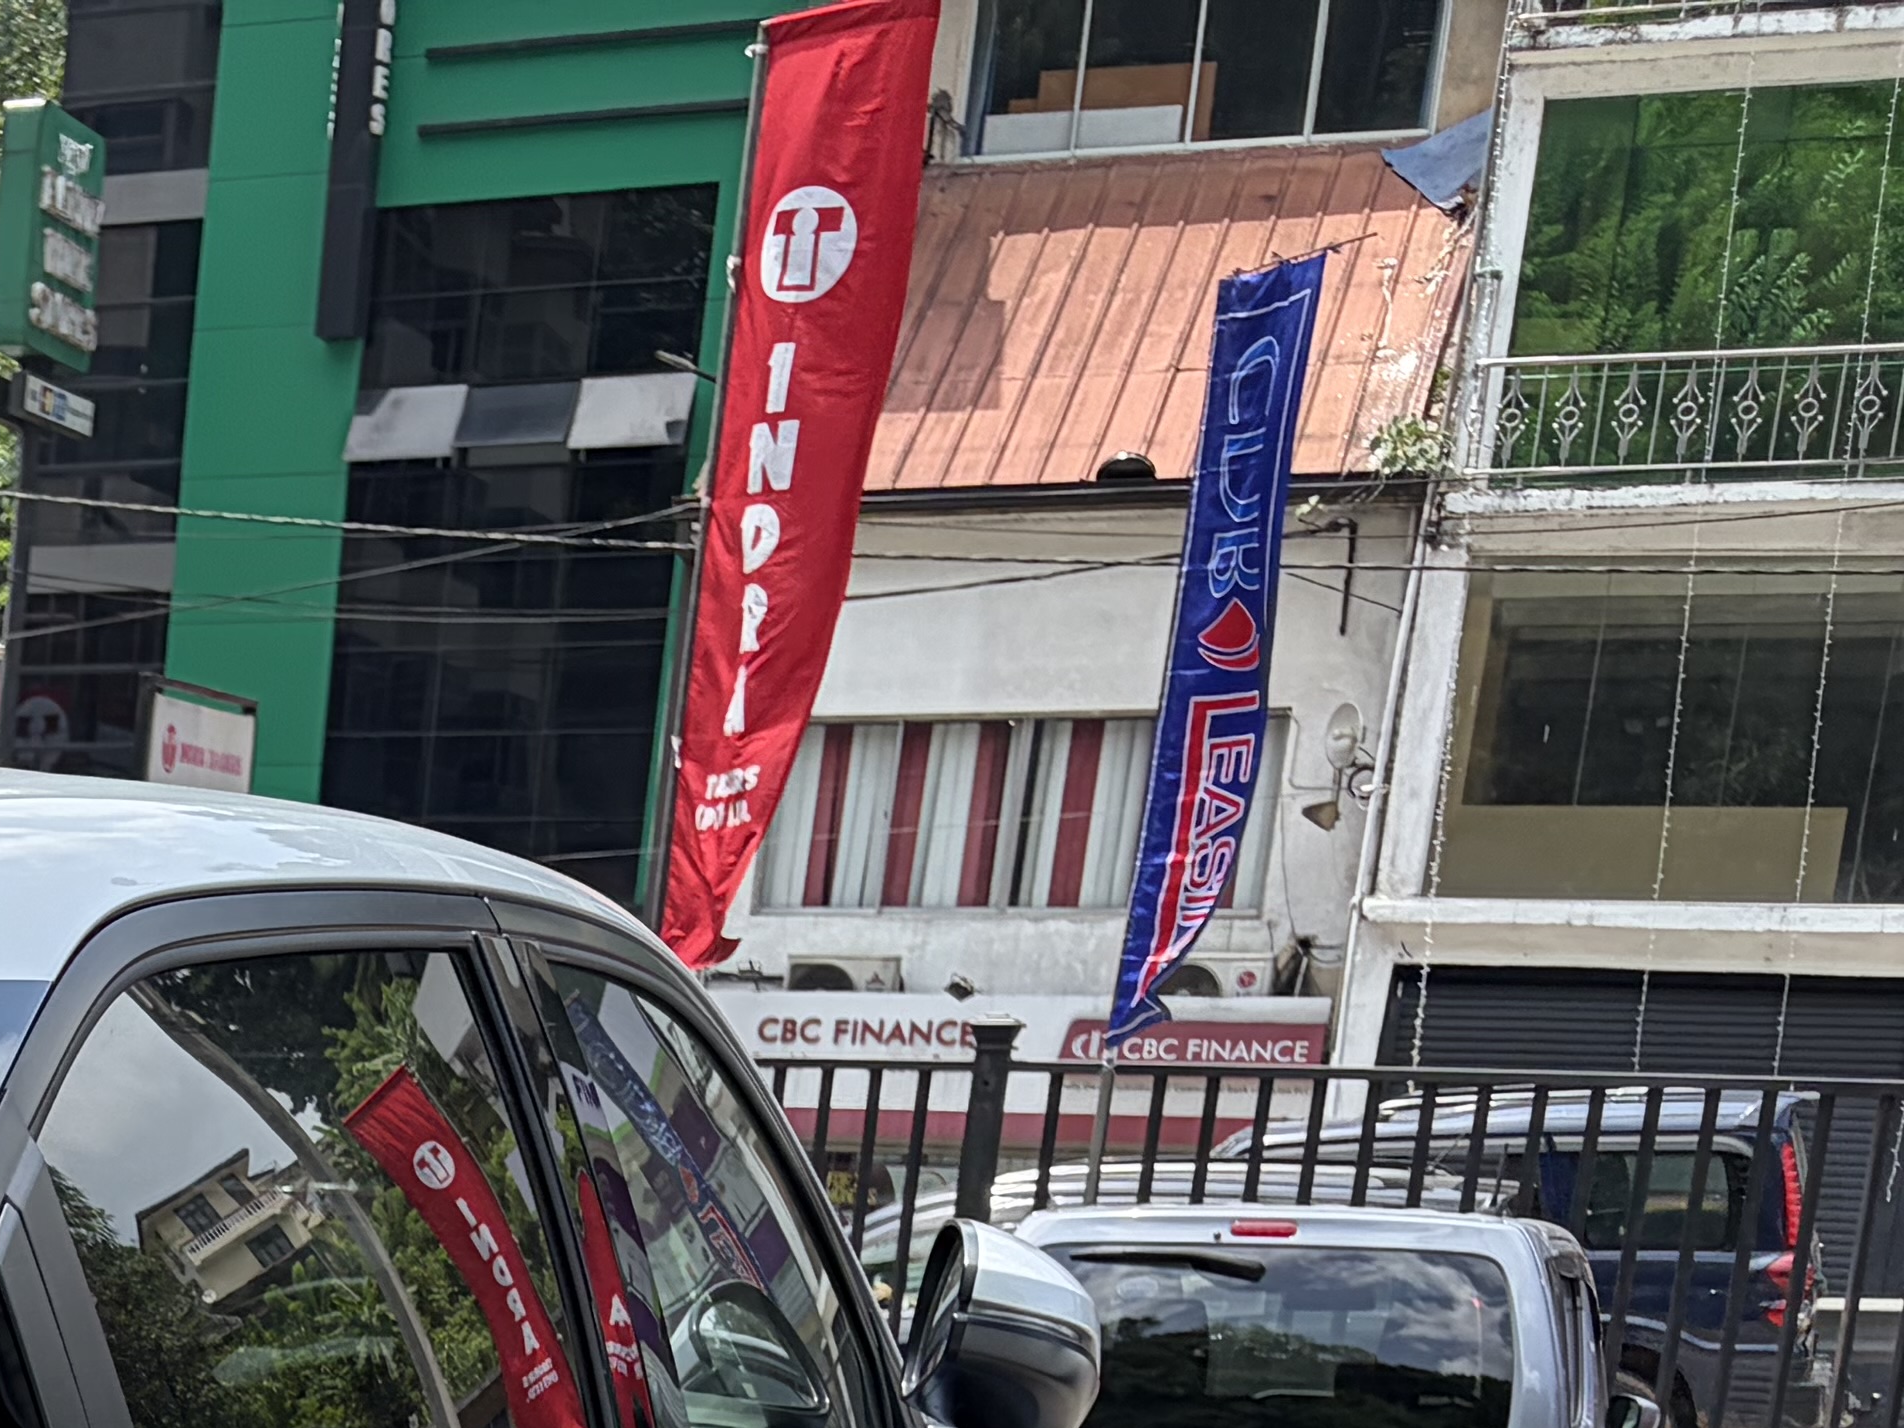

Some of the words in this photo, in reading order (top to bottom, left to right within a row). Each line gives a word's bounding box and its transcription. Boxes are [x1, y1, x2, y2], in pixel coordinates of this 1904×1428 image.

[1130, 690, 1260, 1008] LEASI
[757, 1017, 821, 1045] CBC
[833, 1018, 976, 1048] FINANCE
[1122, 1038, 1180, 1061] CBC
[1187, 1039, 1310, 1063] FINANCE
